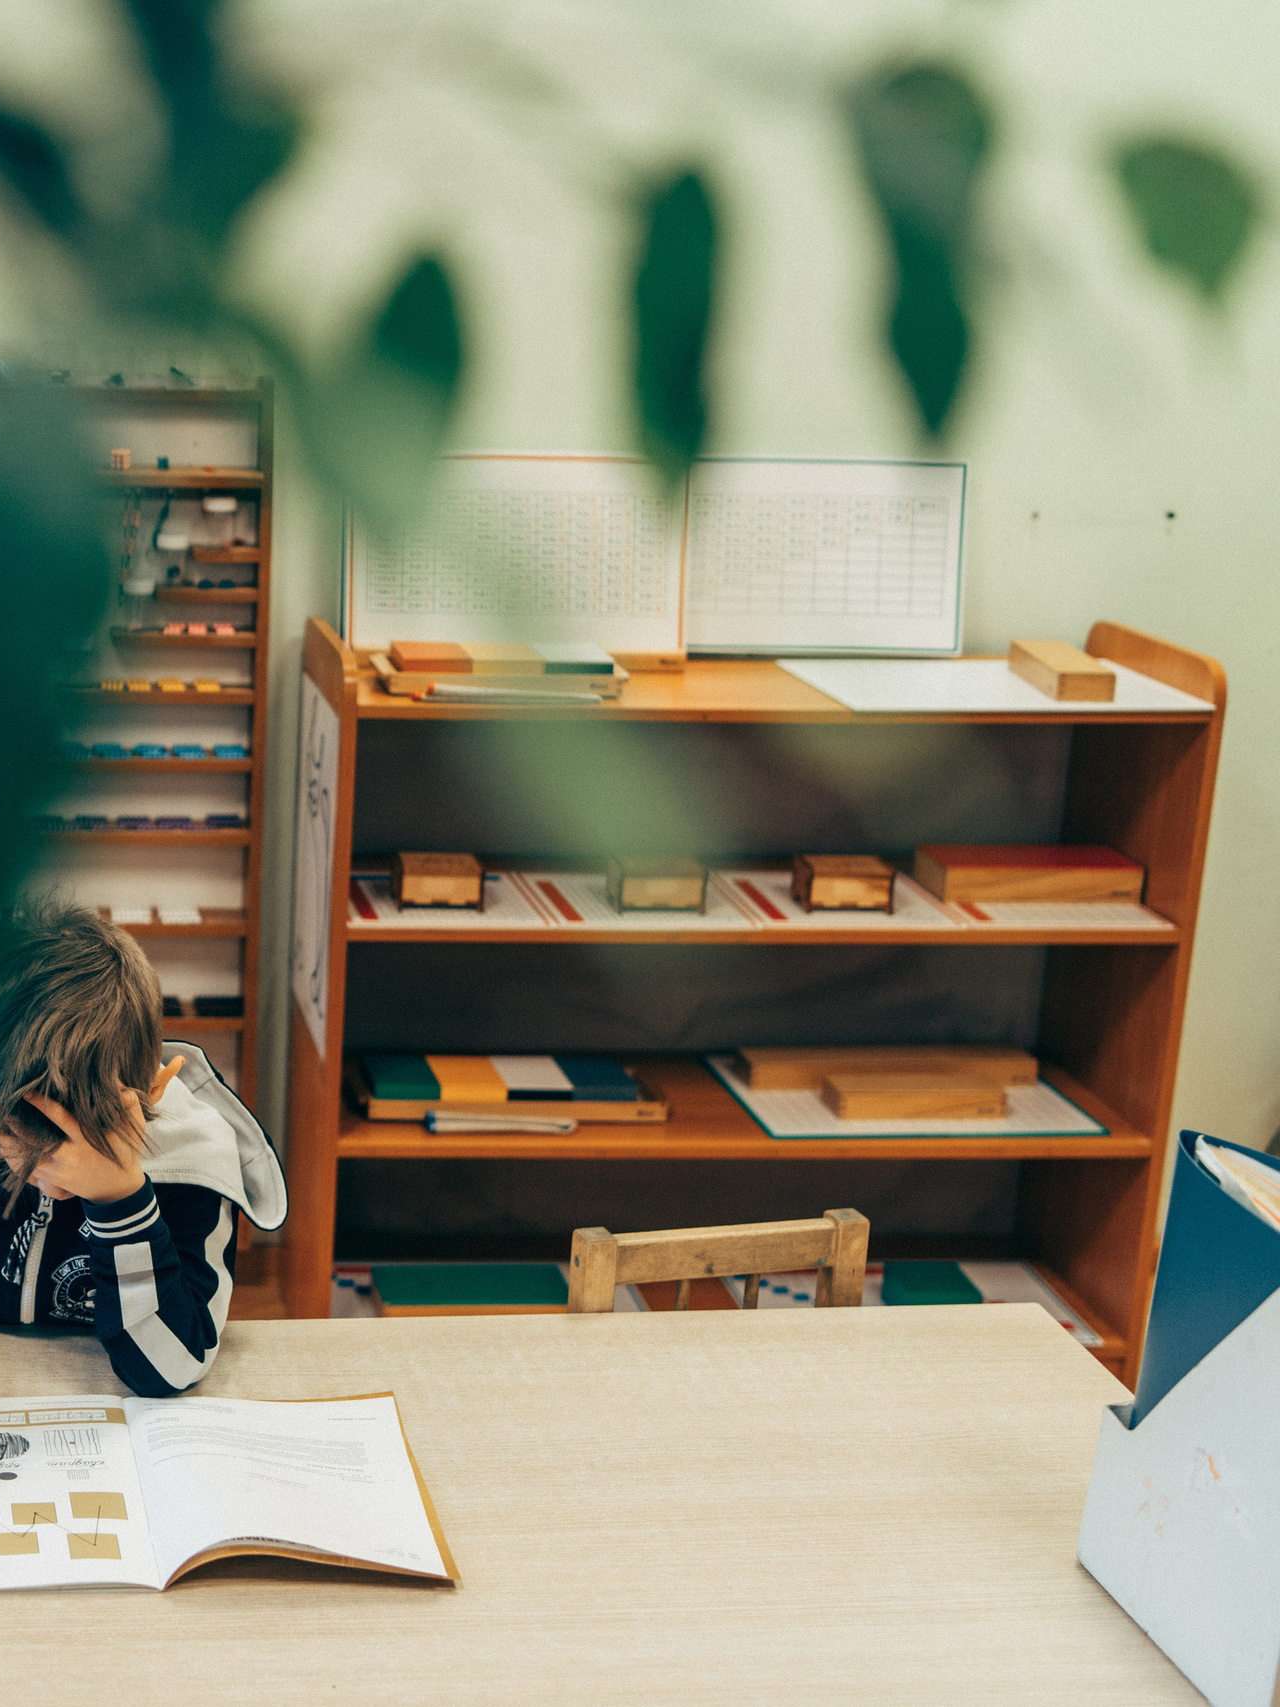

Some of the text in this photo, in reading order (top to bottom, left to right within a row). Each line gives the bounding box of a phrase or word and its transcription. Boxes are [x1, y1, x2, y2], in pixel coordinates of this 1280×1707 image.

[55, 1258, 86, 1280] LONG LIVE
[46, 1458, 105, 1468] квадрат
